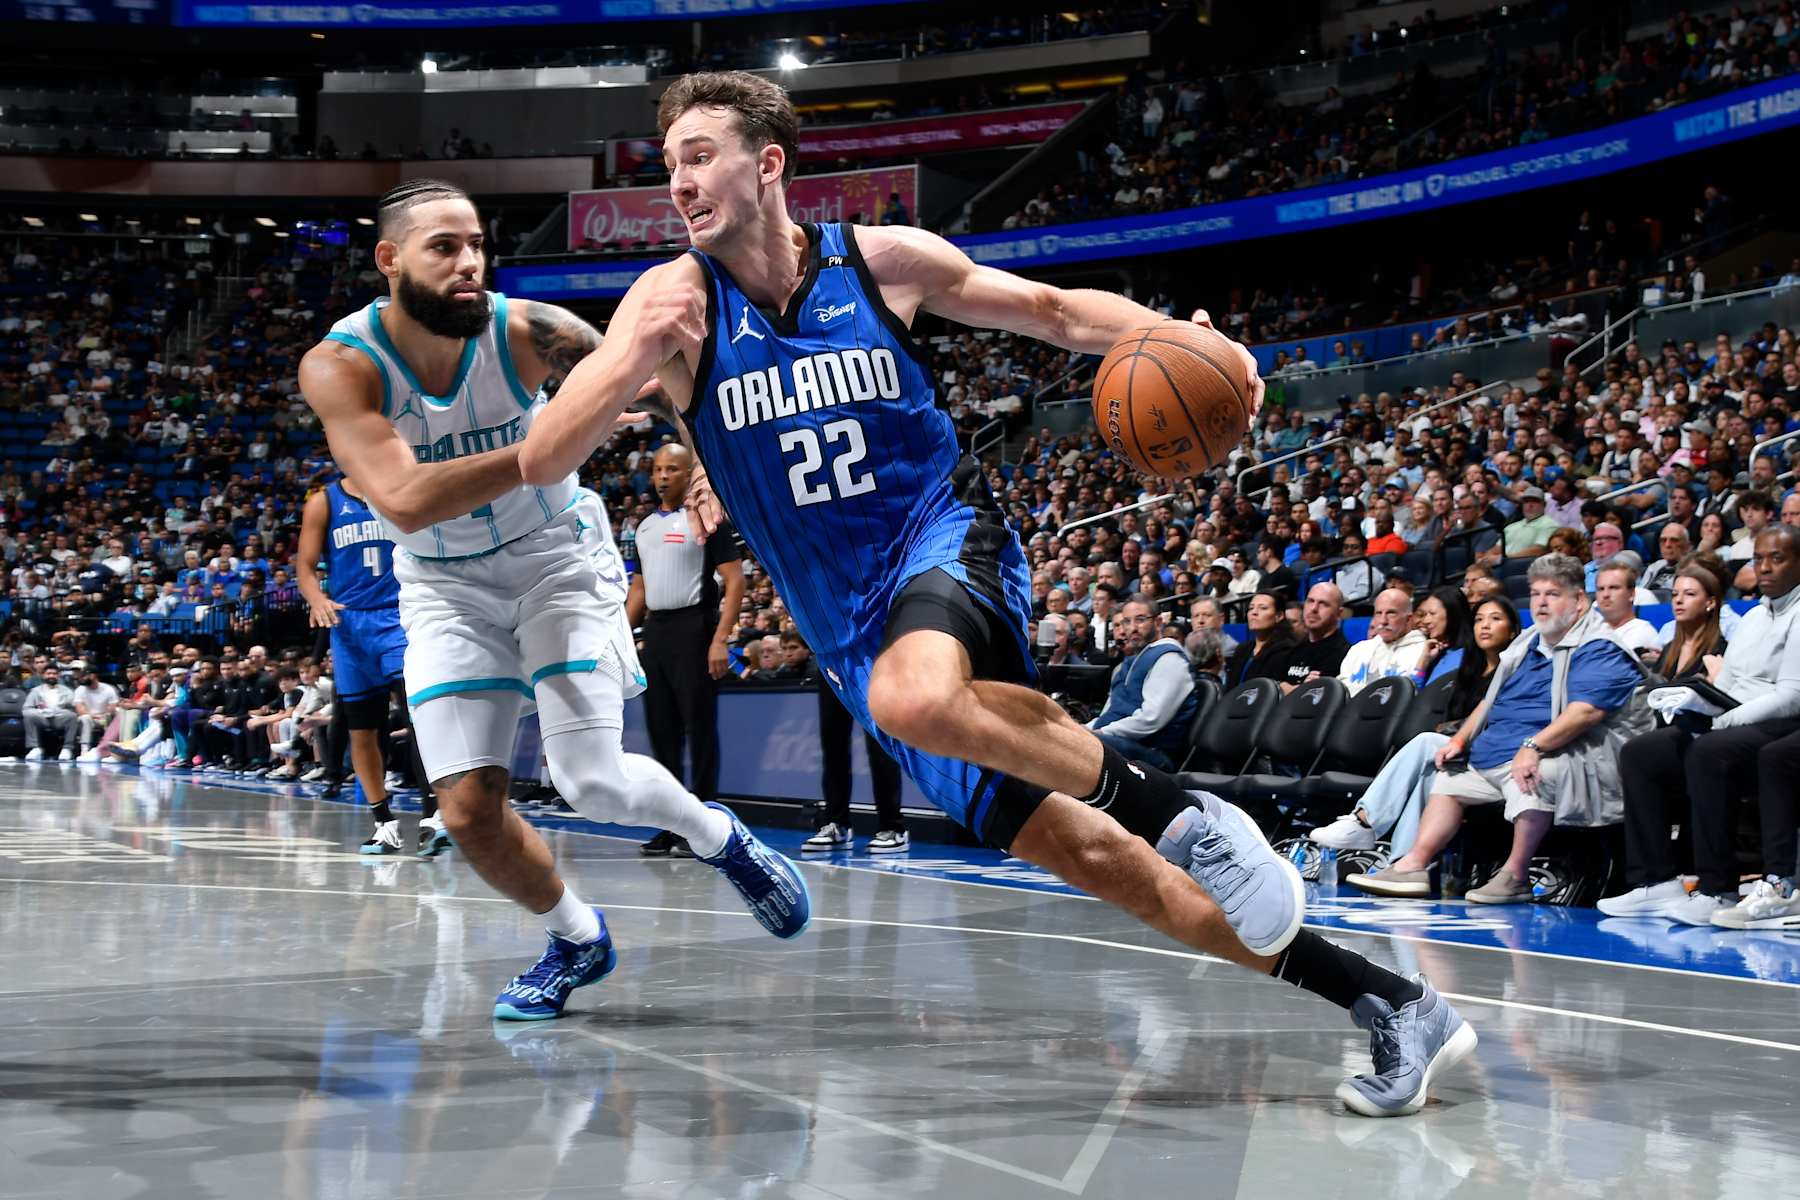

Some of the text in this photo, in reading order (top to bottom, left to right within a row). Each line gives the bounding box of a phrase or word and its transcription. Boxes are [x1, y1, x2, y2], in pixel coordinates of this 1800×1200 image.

[1727, 99, 1758, 128] THE
[1759, 87, 1800, 120] MAGI
[1327, 193, 1355, 215] THE
[1355, 184, 1401, 210] MAGIC
[1509, 154, 1563, 177] SPORTS
[1564, 138, 1630, 165] NETWORK
[790, 196, 845, 223] orld
[828, 255, 843, 266] PW
[812, 301, 856, 322] Disney
[717, 348, 901, 432] ORLANDO
[779, 418, 877, 507] 22
[333, 520, 384, 549] ORLAN
[363, 547, 380, 576] 4
